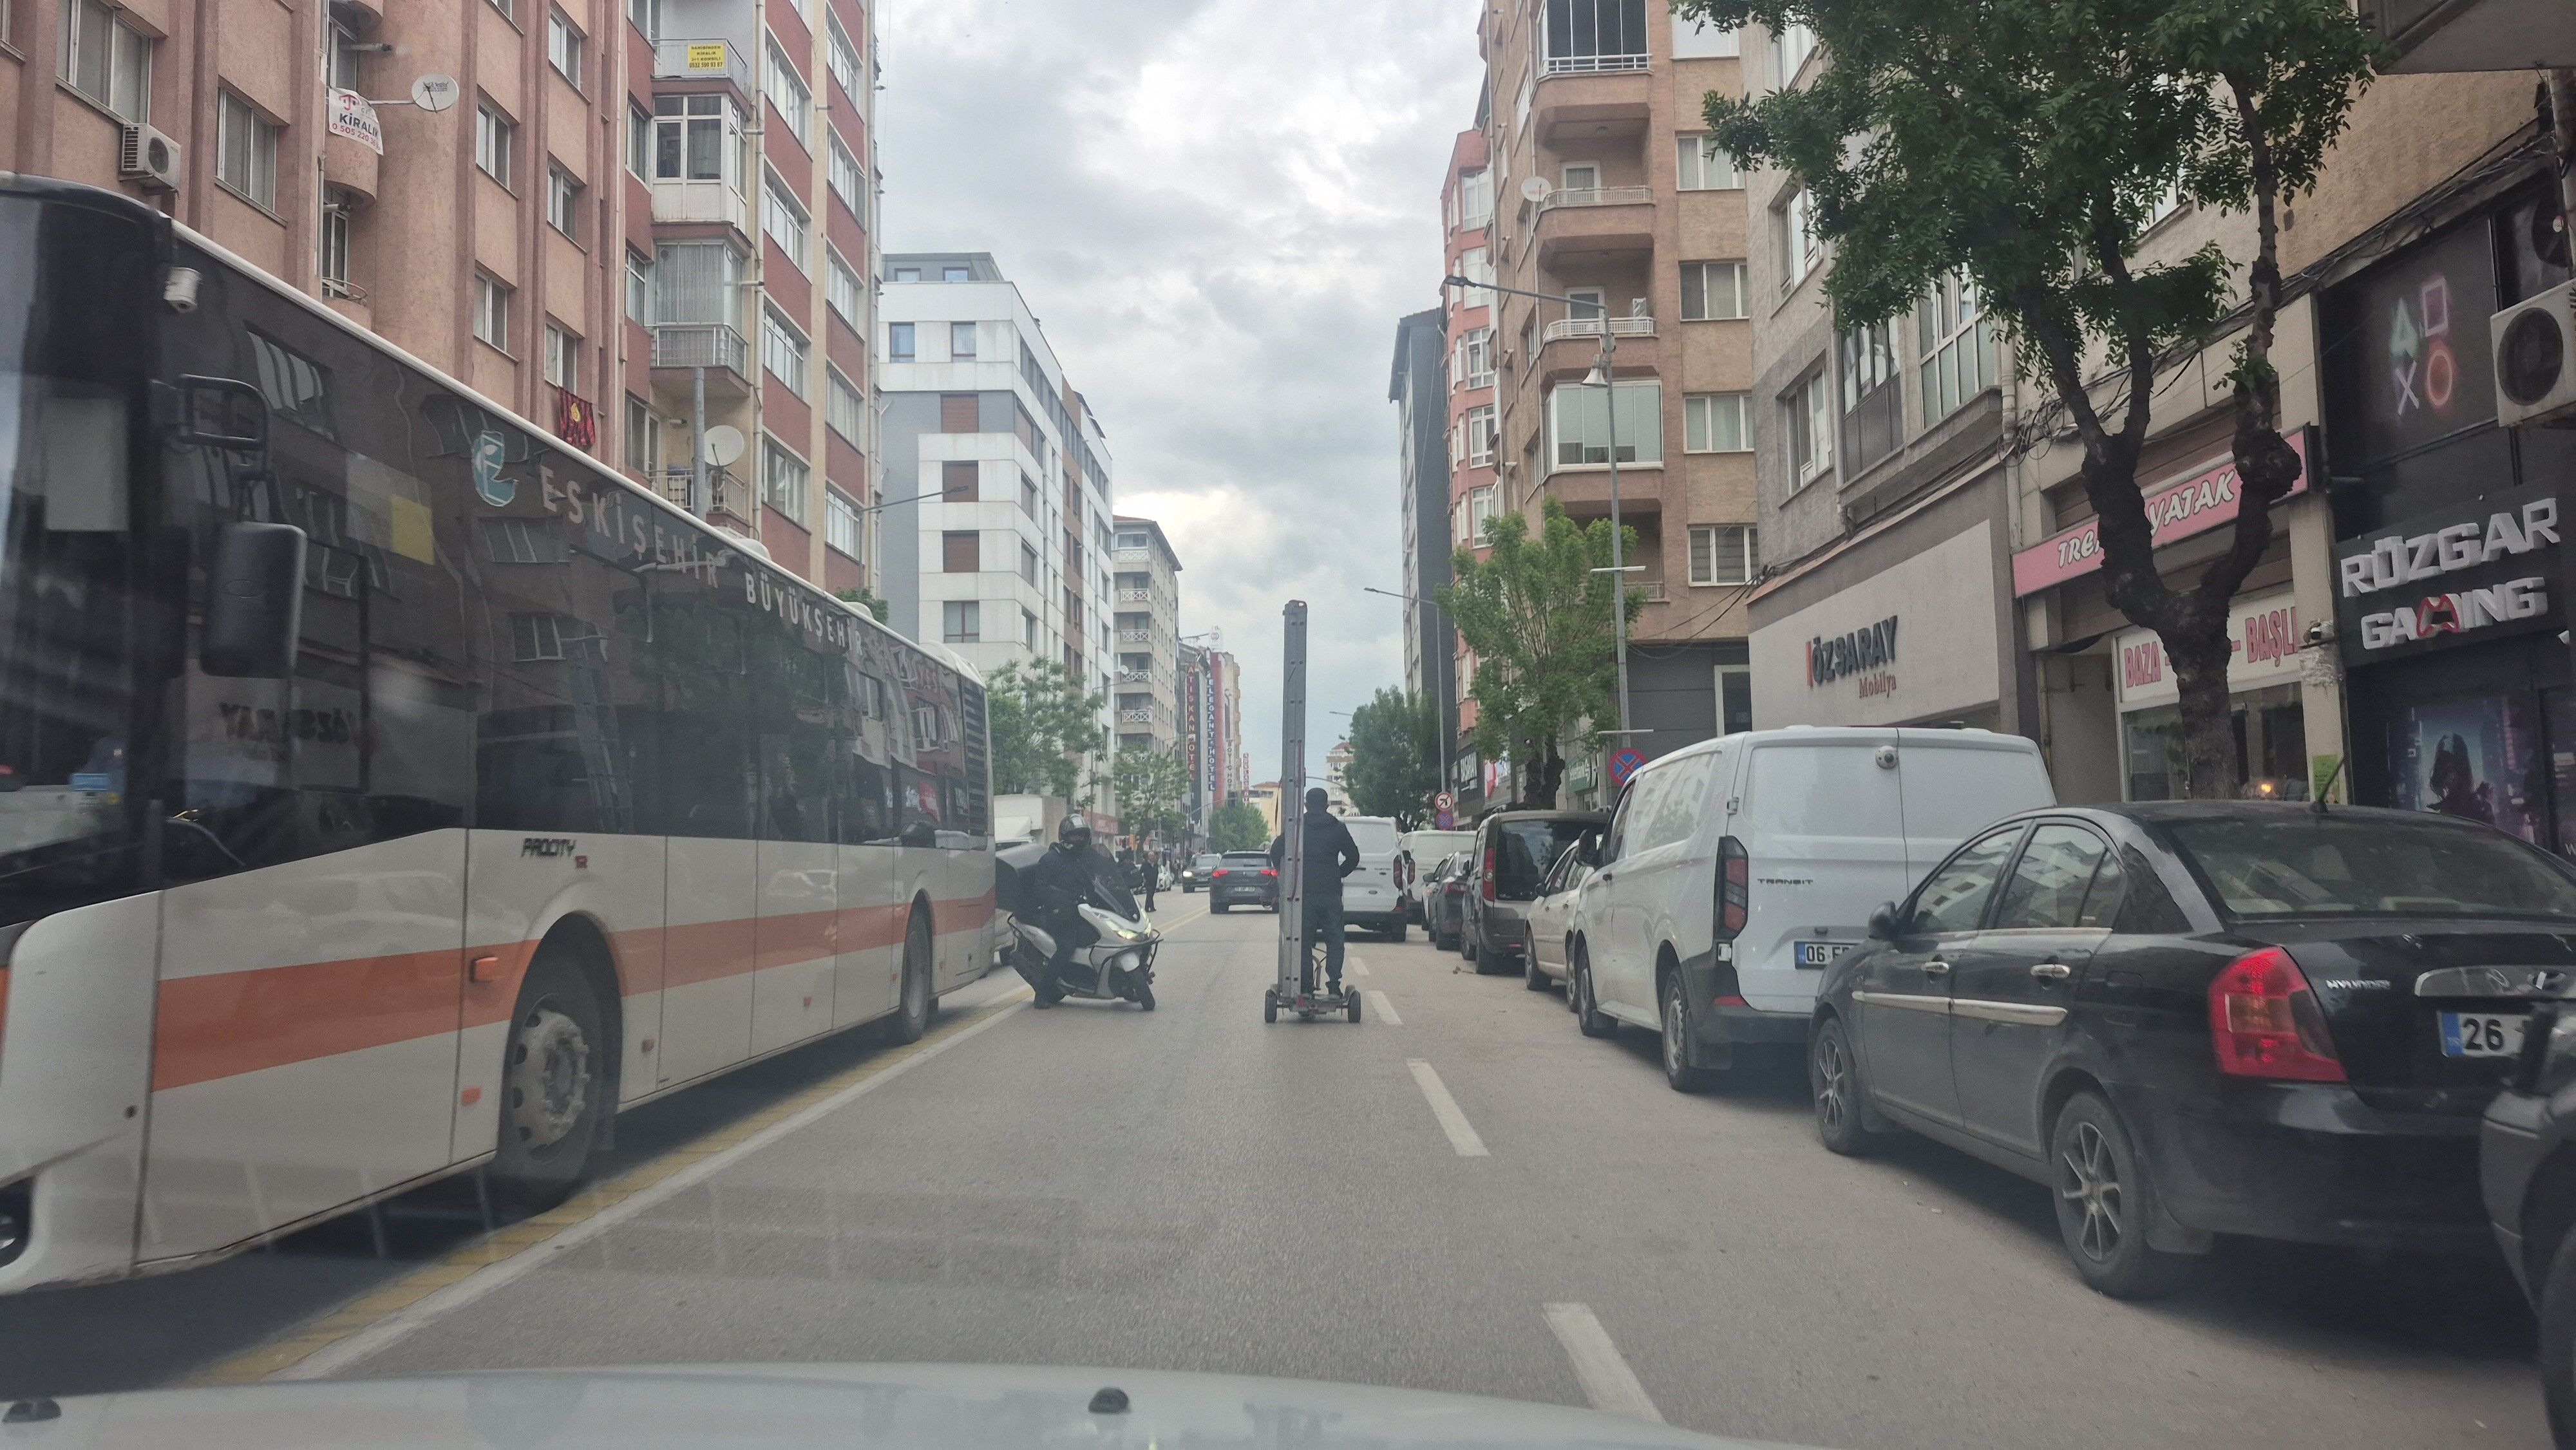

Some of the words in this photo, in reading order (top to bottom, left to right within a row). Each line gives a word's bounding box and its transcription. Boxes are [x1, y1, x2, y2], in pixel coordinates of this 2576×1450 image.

[340, 126, 355, 136] 505
[2148, 469, 2235, 538] YATAK
[540, 464, 719, 589] ESKİŞEHİR
[744, 571, 864, 656] BÜYÜKŞEHİR
[2340, 498, 2561, 598] RÜZGAR
[1812, 614, 1898, 687] ÖZSARAY
[2124, 641, 2162, 688] BAZA
[1859, 670, 1897, 699] Mobilya
[1806, 945, 1825, 963] 06
[2463, 1018, 2504, 1051] 26
